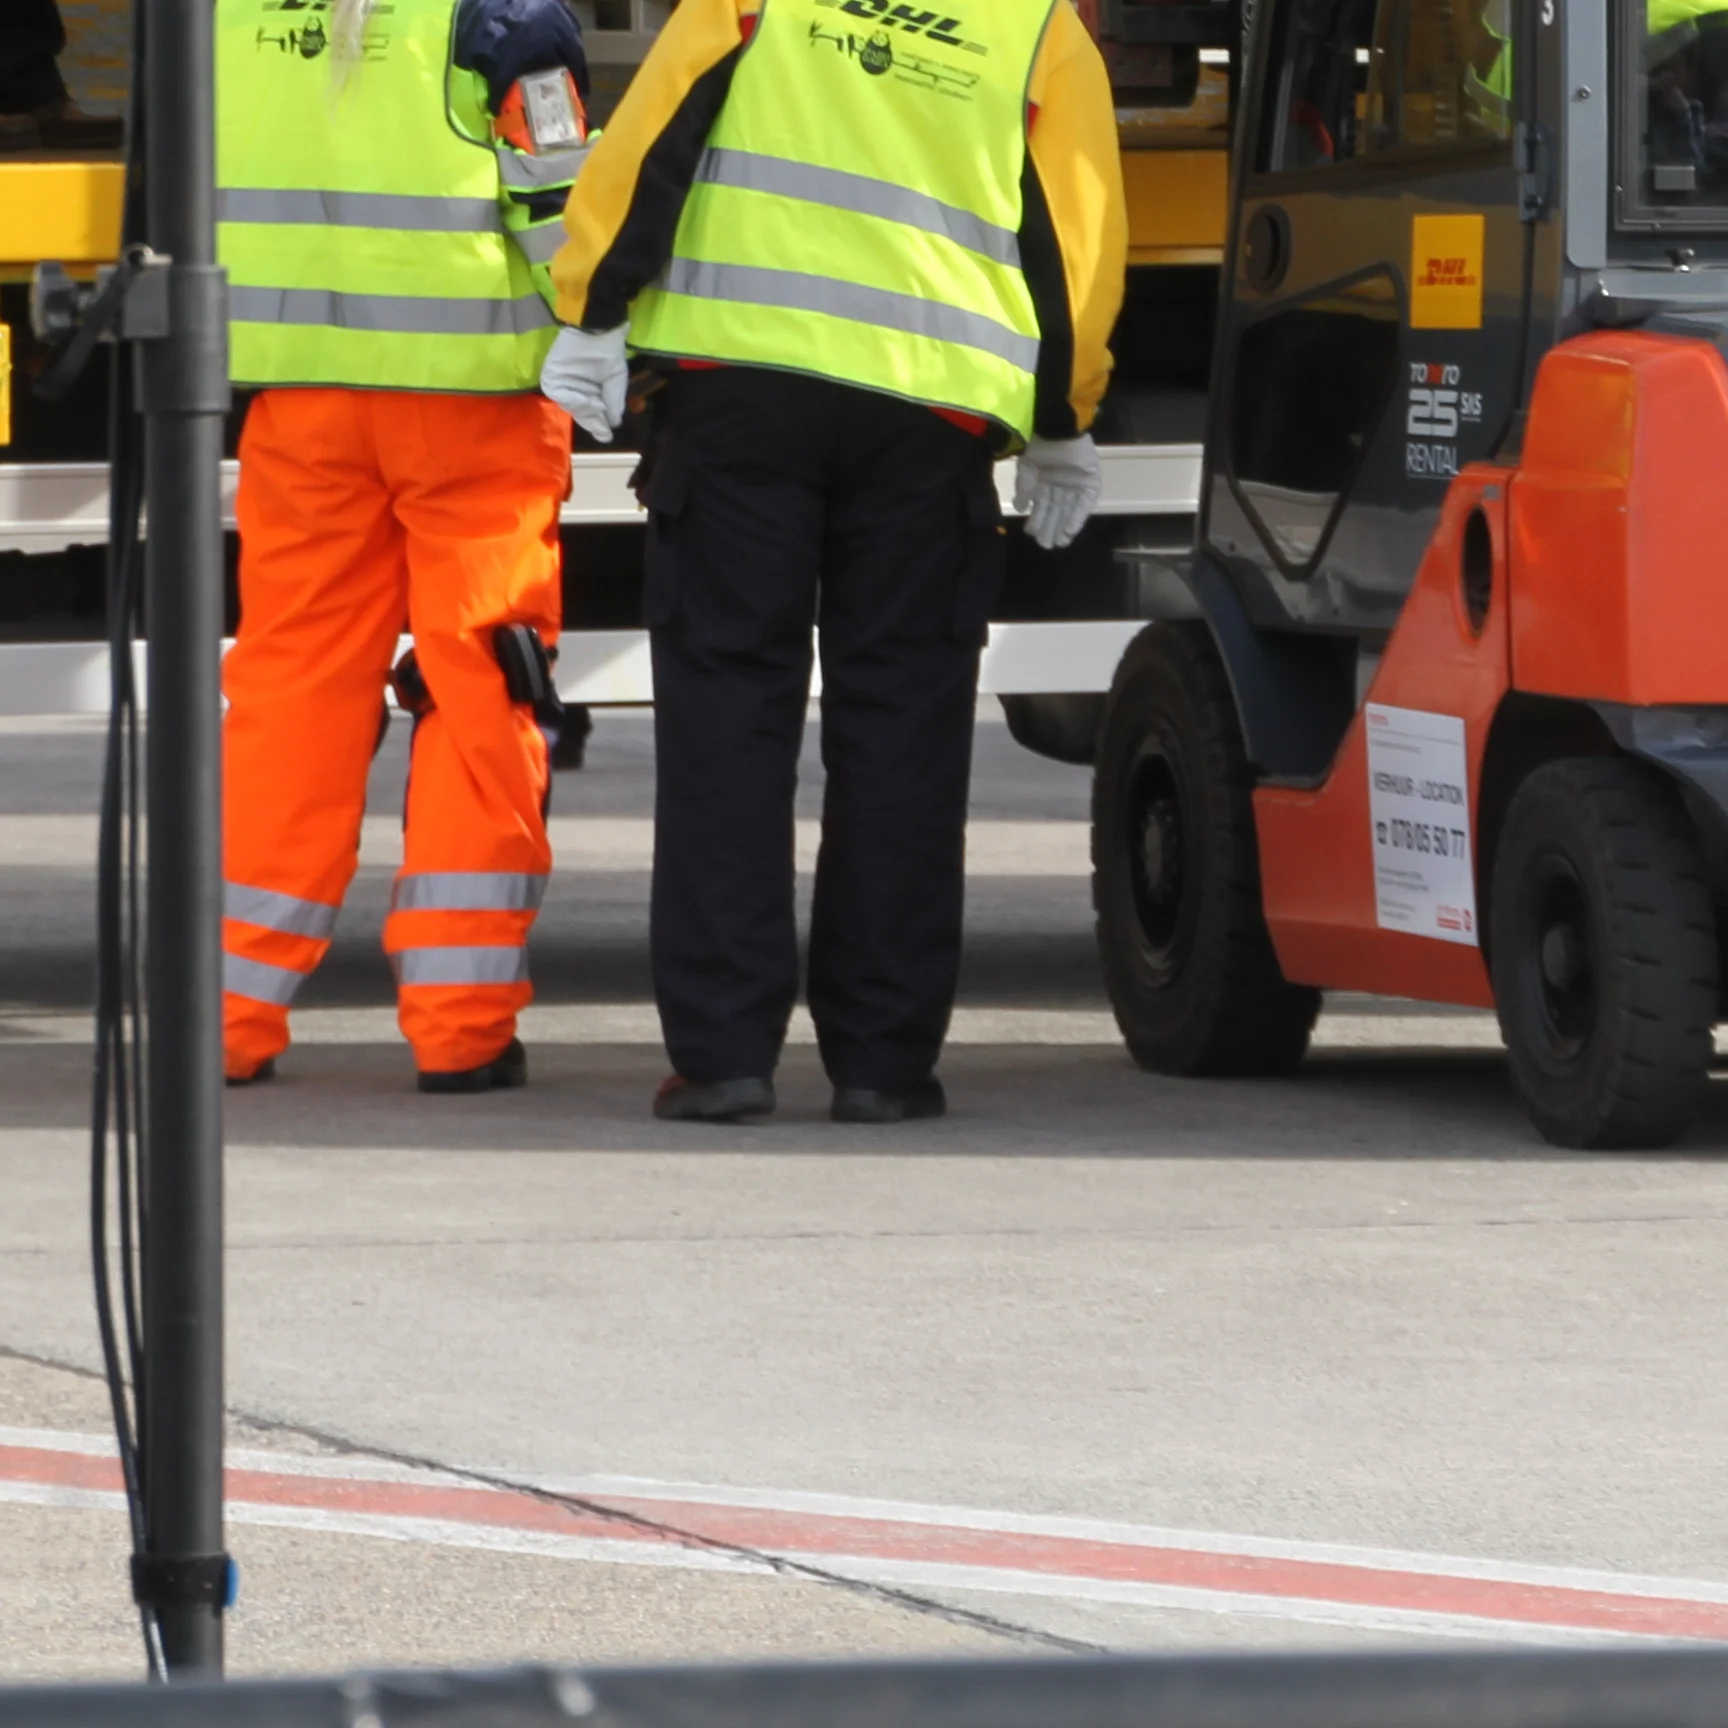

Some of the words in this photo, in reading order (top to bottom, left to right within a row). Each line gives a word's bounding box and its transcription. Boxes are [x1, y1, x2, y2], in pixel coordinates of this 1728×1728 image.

[1426, 258, 1468, 286] DHL
[1407, 388, 1459, 437] 25
[1407, 442, 1459, 476] RENTAL
